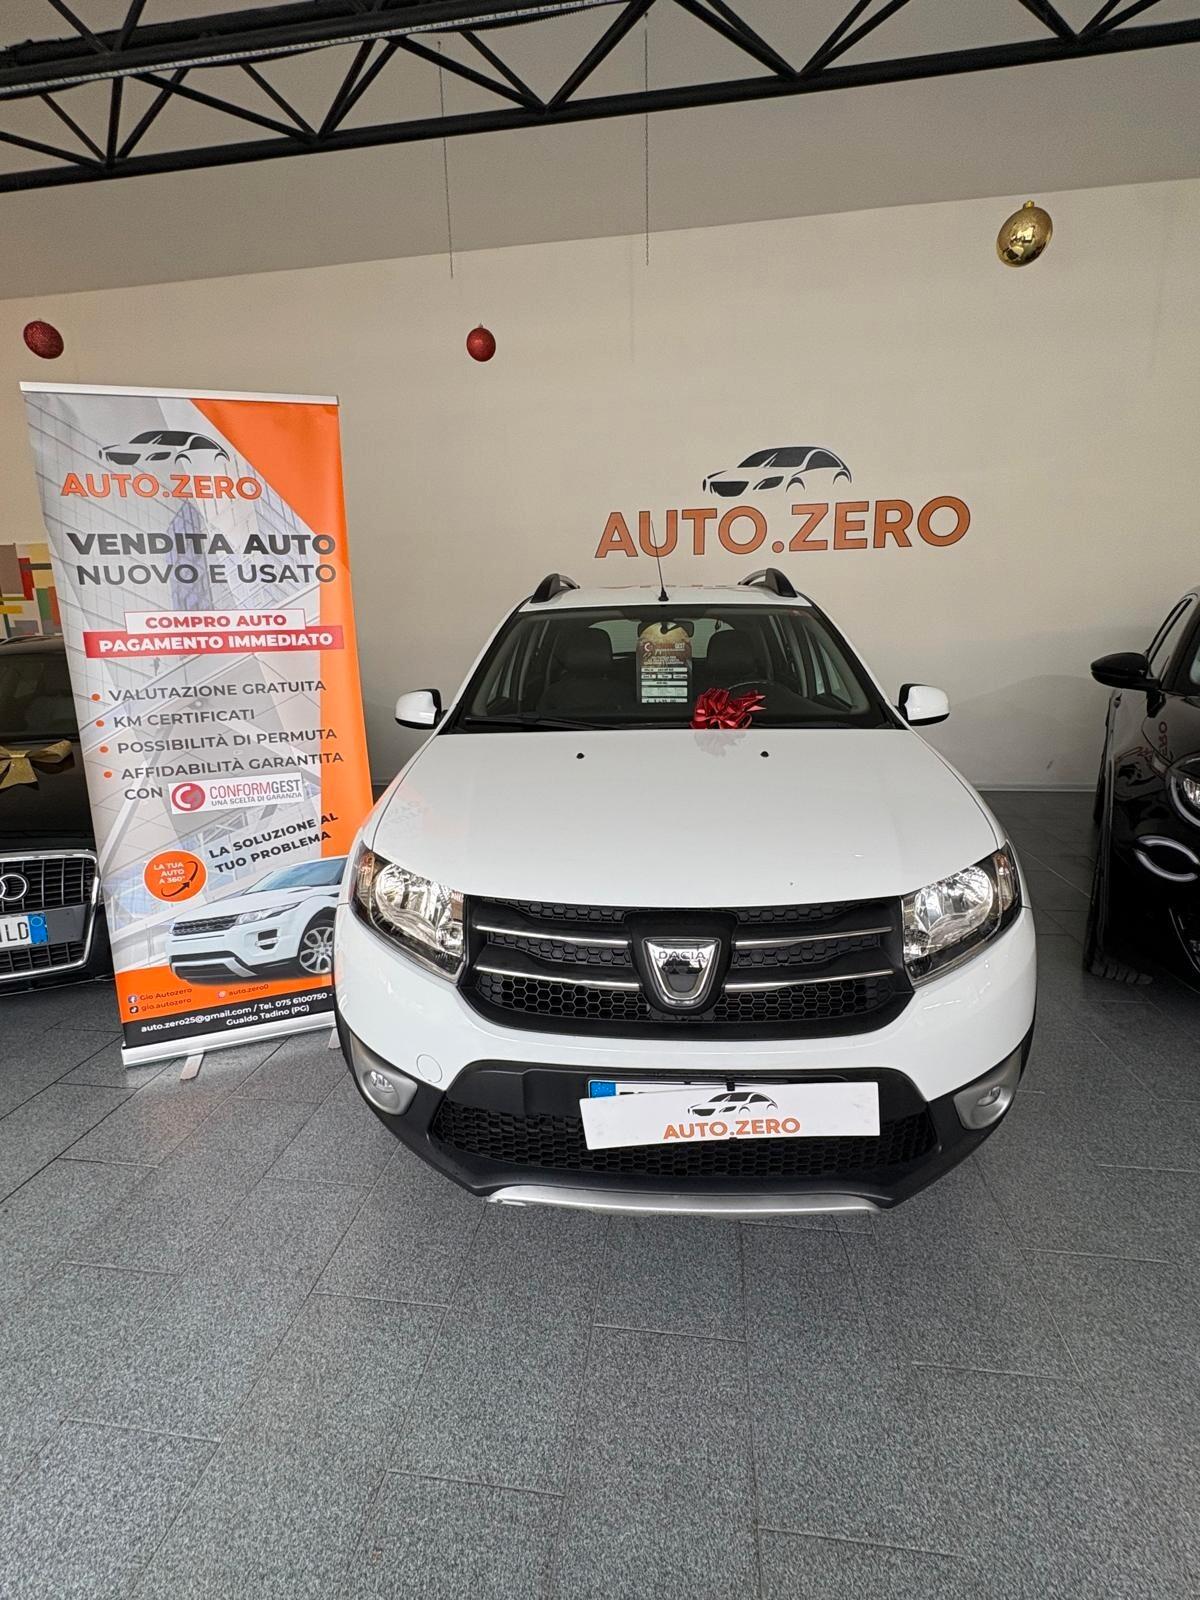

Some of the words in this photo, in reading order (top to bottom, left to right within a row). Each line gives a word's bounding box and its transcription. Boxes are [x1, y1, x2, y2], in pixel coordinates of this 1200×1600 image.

[61, 473, 262, 500] AUTO.ZERO
[594, 495, 971, 559] AUTO.ZERO
[66, 533, 233, 555] VENDITA
[242, 534, 336, 555] AUTO
[77, 564, 198, 585] NUOVO
[210, 564, 228, 584] E
[237, 564, 337, 583] USATO
[145, 615, 231, 629] COMPRO
[236, 614, 287, 627] AUTO
[99, 635, 225, 652] PAGAMENTO
[228, 633, 333, 648] IMMEDIATO
[108, 684, 237, 702] VALUTAZIONE
[242, 680, 326, 695] GRATUITA
[114, 716, 142, 728] KM
[147, 709, 255, 726] CERTIFICATI
[117, 733, 228, 753] POSSIBILITÀ
[234, 734, 251, 746] DI
[257, 728, 337, 745] PERMUTA
[121, 758, 244, 780] AFFIDABILITÀ
[248, 752, 344, 770] GARANTITA
[124, 787, 163, 801] CON
[210, 780, 301, 799] CONFORMGEST
[229, 797, 255, 805] SCELTA
[266, 792, 302, 801] GARANZIA
[209, 846, 230, 858] LA
[233, 819, 316, 851] SOLUZIONE
[321, 813, 339, 825] AL
[215, 857, 247, 873] TUO
[251, 831, 331, 862] PROBLEMA
[161, 869, 185, 877] AUTO
[658, 951, 706, 960] DACIA
[156, 988, 192, 998] Autozero
[141, 1006, 251, 1033] auto.zero25@gmail.com
[259, 1002, 274, 1010] Tel.
[275, 999, 291, 1007] 075
[293, 992, 327, 1004] 6100750
[226, 1014, 258, 1026] Gualdo
[260, 1009, 290, 1020] Tadino
[291, 1005, 310, 1015] (PG)
[663, 1117, 801, 1140] AUTO.ZERO
